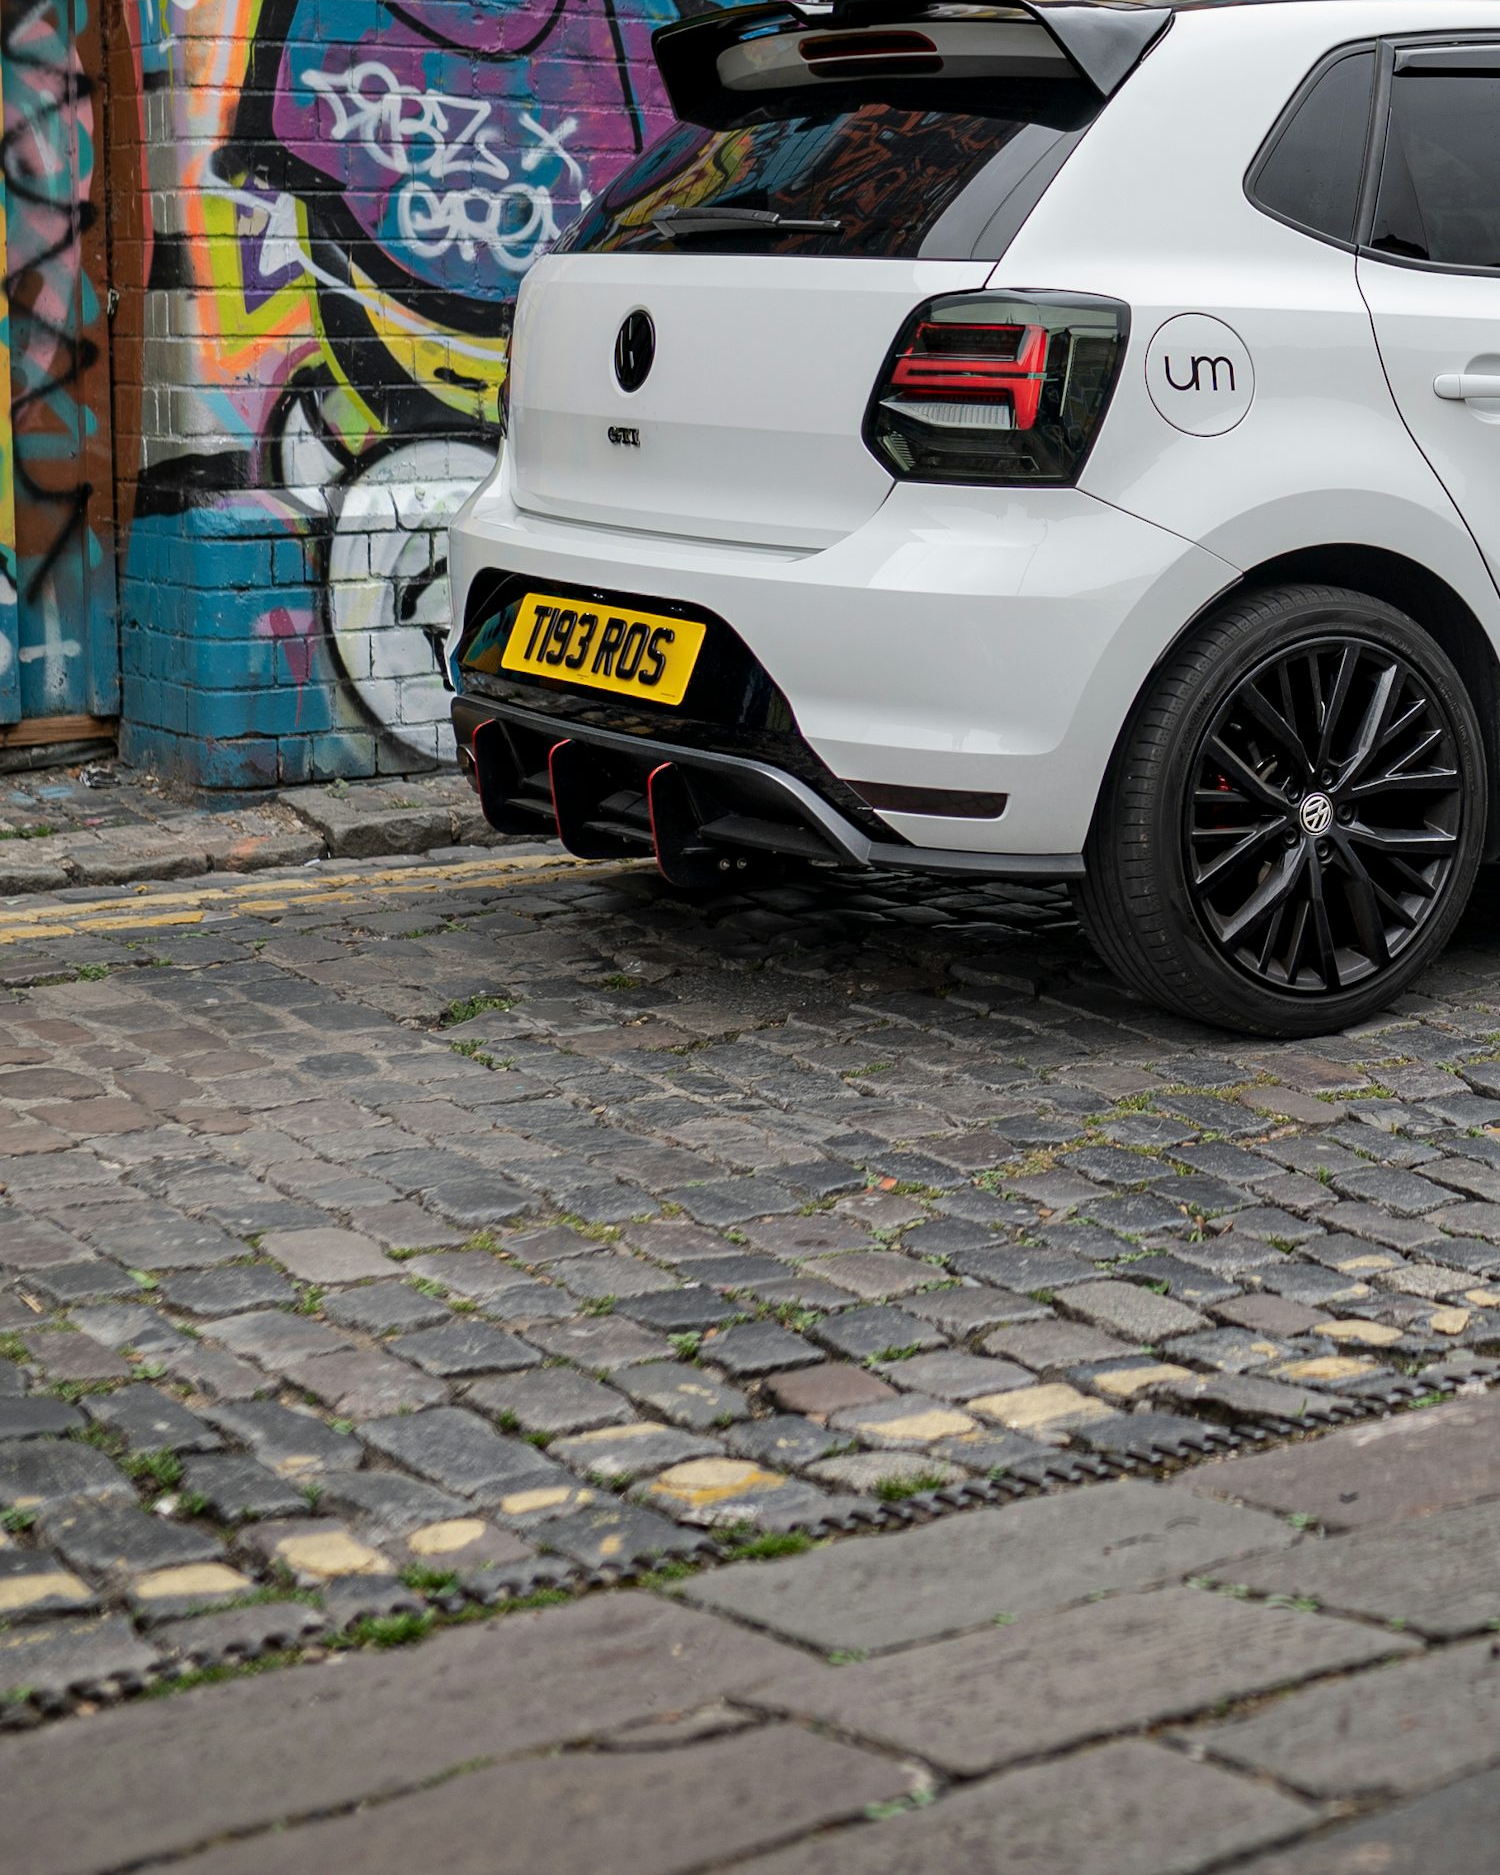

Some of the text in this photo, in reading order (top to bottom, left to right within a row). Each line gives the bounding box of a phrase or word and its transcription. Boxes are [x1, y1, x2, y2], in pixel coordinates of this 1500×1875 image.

[1163, 355, 1235, 391] um
[607, 425, 640, 446] GTI
[523, 605, 676, 687] T193 ROS
